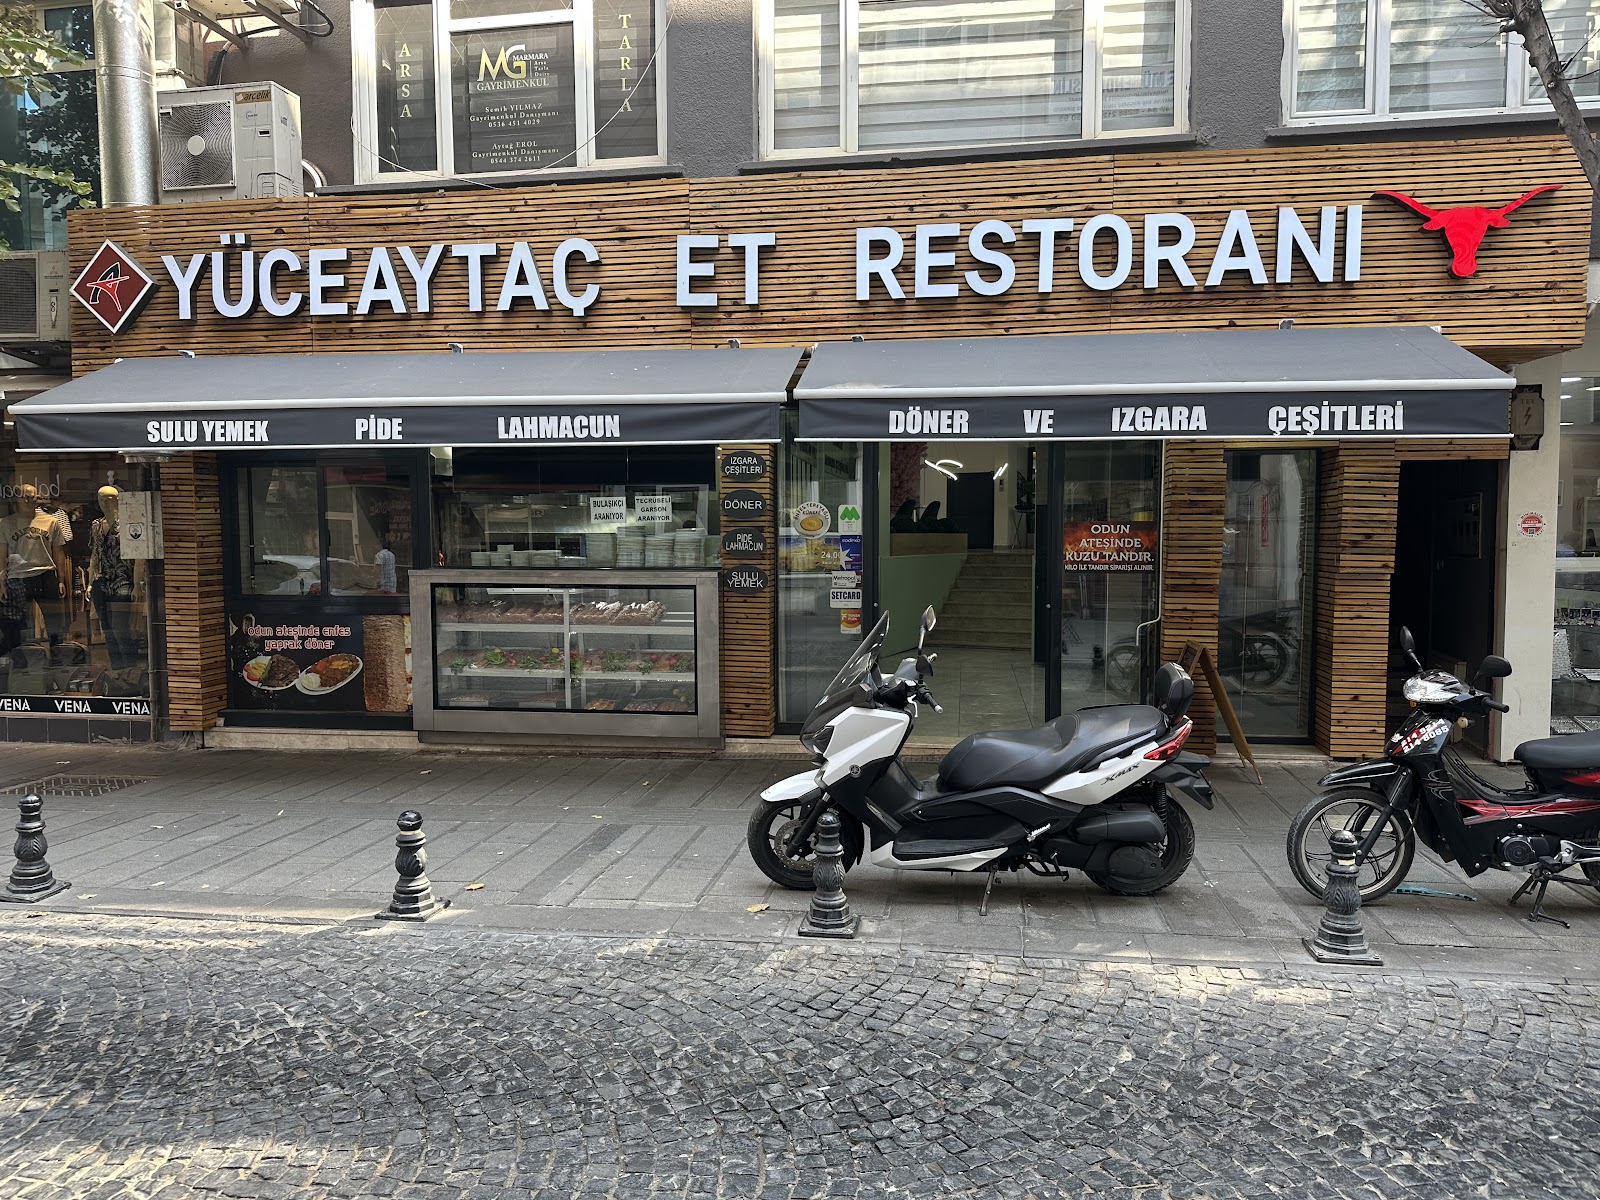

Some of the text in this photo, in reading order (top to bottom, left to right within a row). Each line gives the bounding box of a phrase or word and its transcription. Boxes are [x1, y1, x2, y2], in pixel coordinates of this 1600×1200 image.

[512, 53, 548, 61] MARMARA
[618, 14, 633, 113] TARLA
[398, 43, 412, 118] ARSA
[477, 78, 549, 91] GAYRİMENKUL
[510, 103, 543, 111] YILMAZ
[469, 113, 517, 123] Gayrimenkul
[472, 148, 559, 159] Gayrimenkul Danışmanı
[161, 205, 1363, 319] YÜCEAYTAÇ ET RESTORANI
[889, 400, 1404, 436] DÖNER VE IZGARA ÇEŞİTLERİ
[147, 414, 621, 442] SULU YEMEK PİDE LAHMACUN
[724, 464, 763, 475] ÇEŞİTLERİ
[593, 499, 624, 509] BULAŞIKÇI
[724, 499, 763, 510] DÖNER
[594, 512, 624, 520] ARANIYOR
[1090, 524, 1130, 534] ODUN
[736, 533, 753, 544] PİDE
[1079, 536, 1142, 550] ATEŞİNDE
[725, 541, 763, 551] LAHMACUN
[1065, 551, 1155, 562] KUZU TANDIR.
[731, 571, 759, 581] SULU
[727, 579, 764, 588] YEMEK
[831, 591, 861, 600] SETCARD
[248, 625, 351, 641] odun ateşinde enfes
[264, 638, 336, 651] yaprak döner
[54, 699, 91, 713] VENA
[111, 701, 150, 715] VENA
[1423, 725, 1450, 742] 8085
